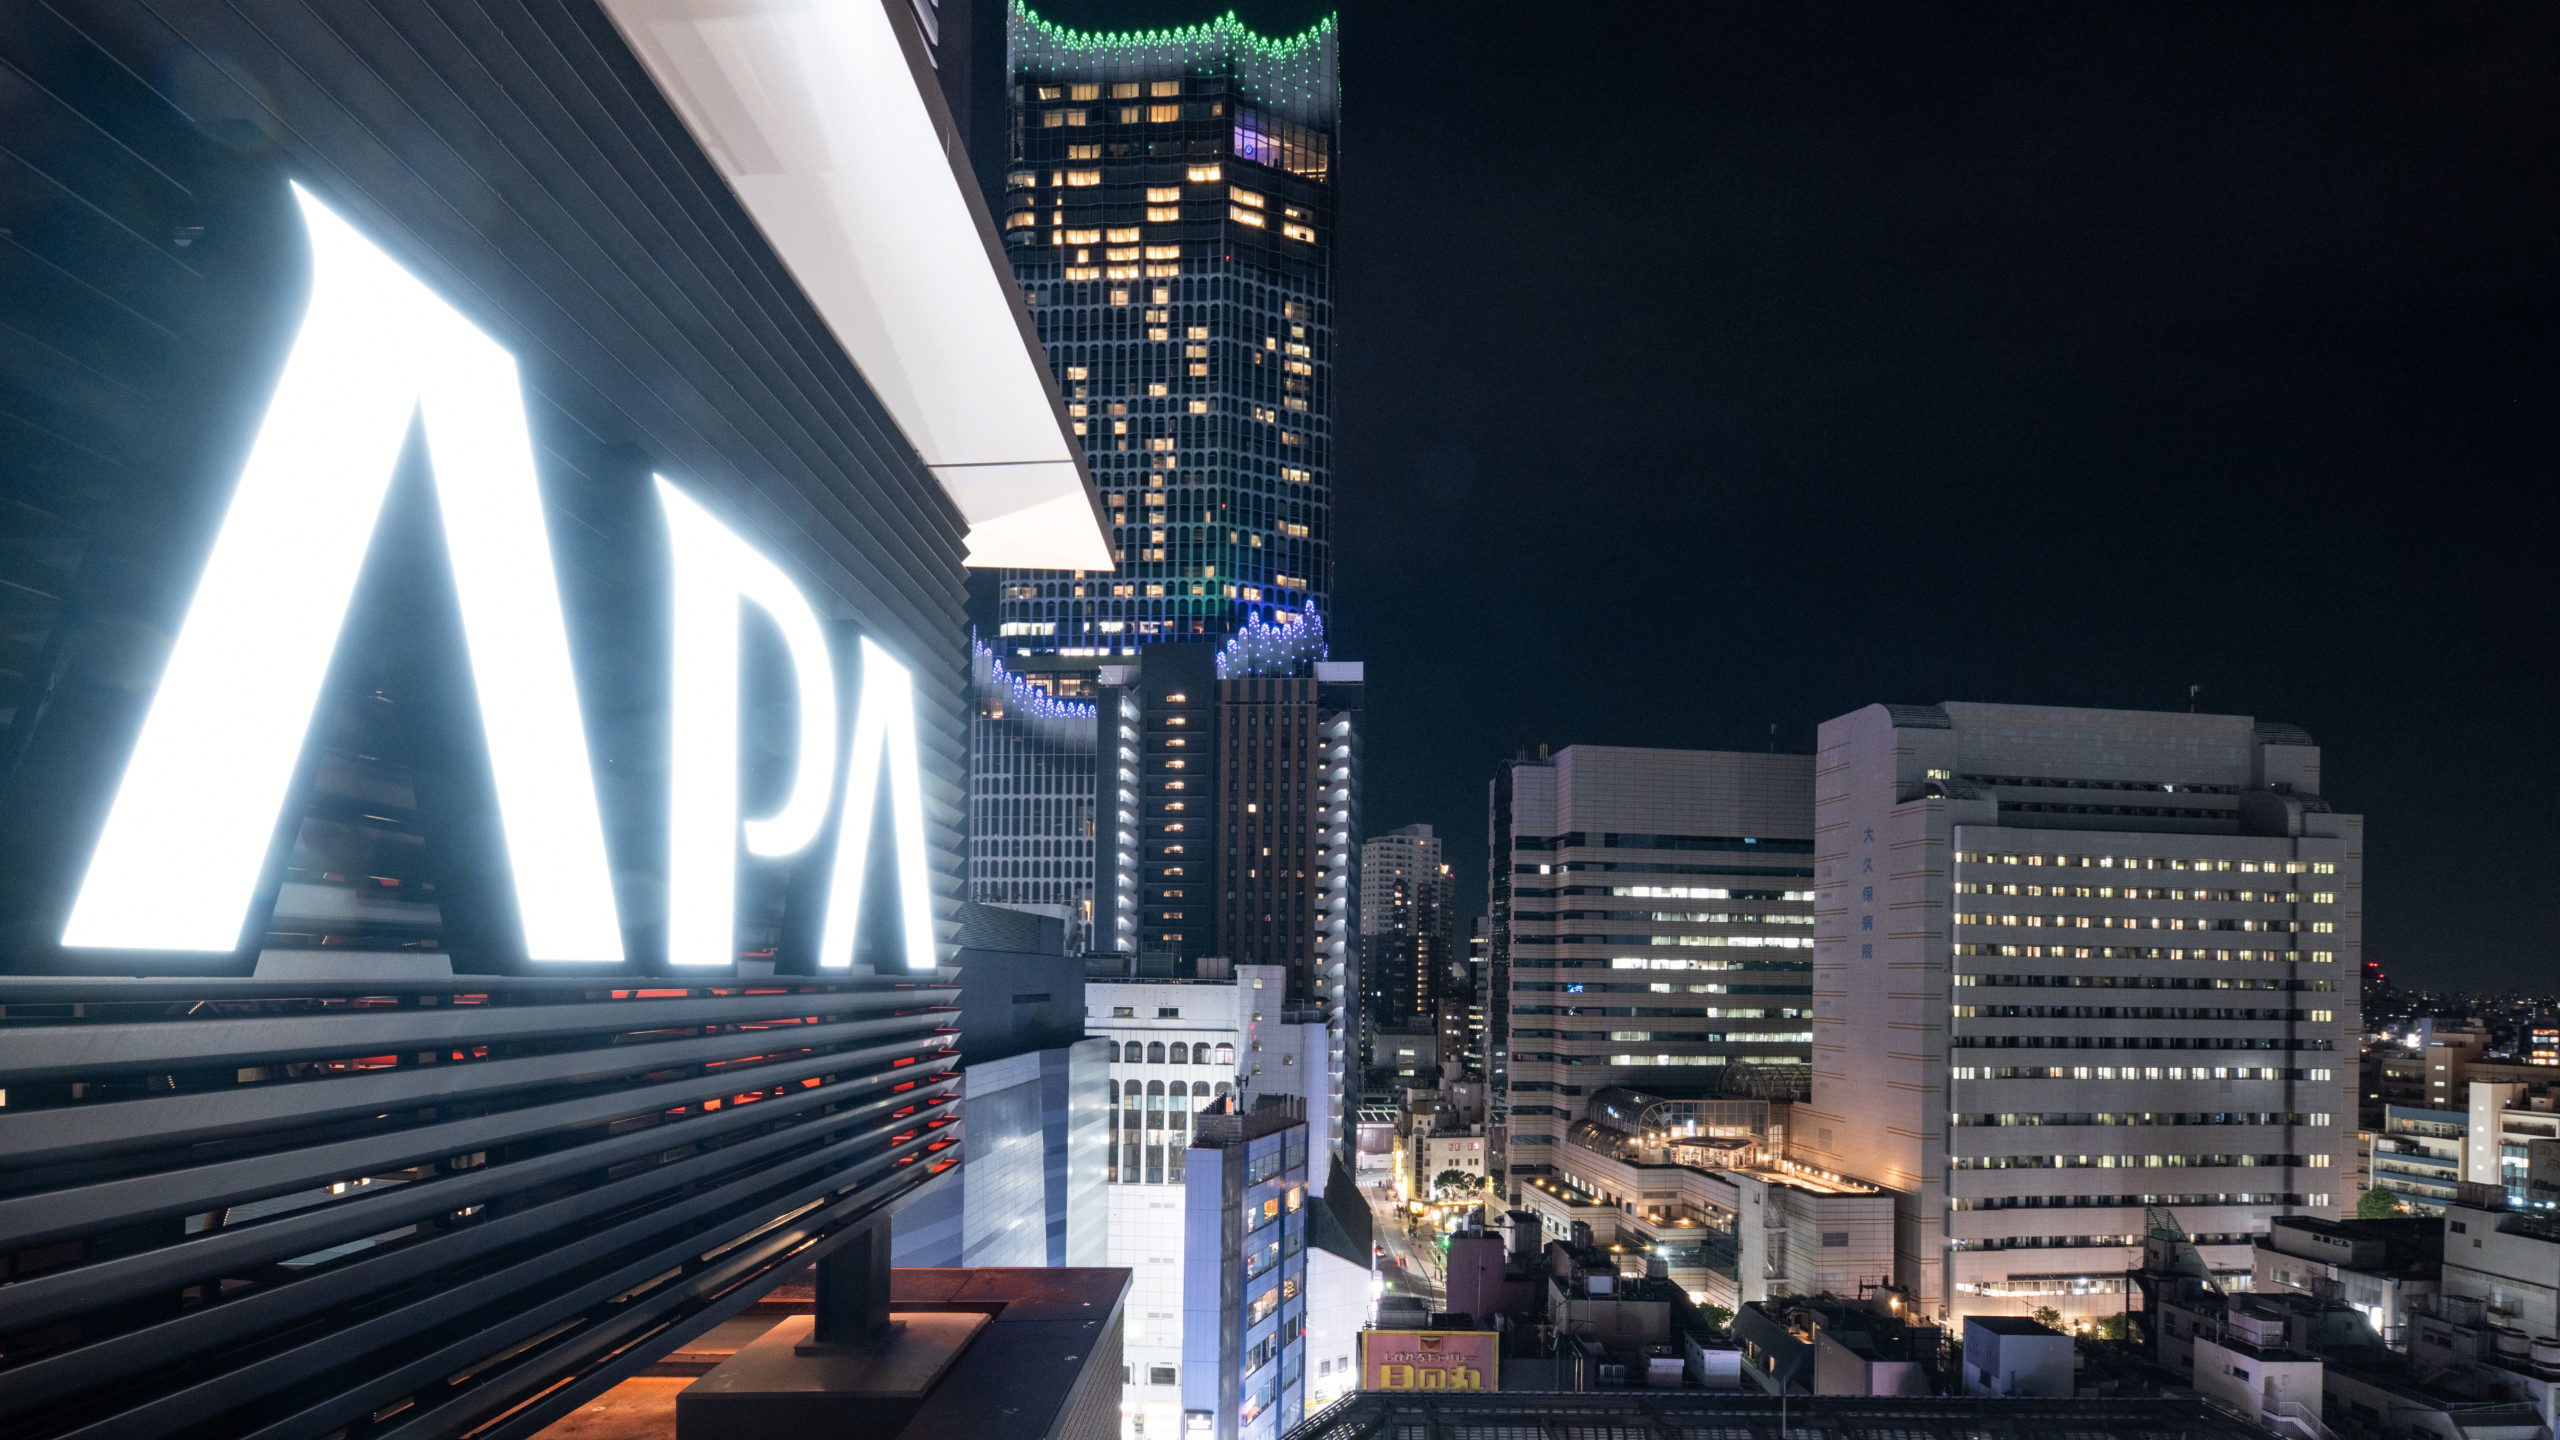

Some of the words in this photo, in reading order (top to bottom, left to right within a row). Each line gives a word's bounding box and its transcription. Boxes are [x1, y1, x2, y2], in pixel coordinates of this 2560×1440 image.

[61, 178, 937, 969] APA
[1861, 826, 1874, 960] 大久保病院
[1379, 1364, 1484, 1391] 日の丸
[1384, 1351, 1477, 1363] しびれるキャバレー
